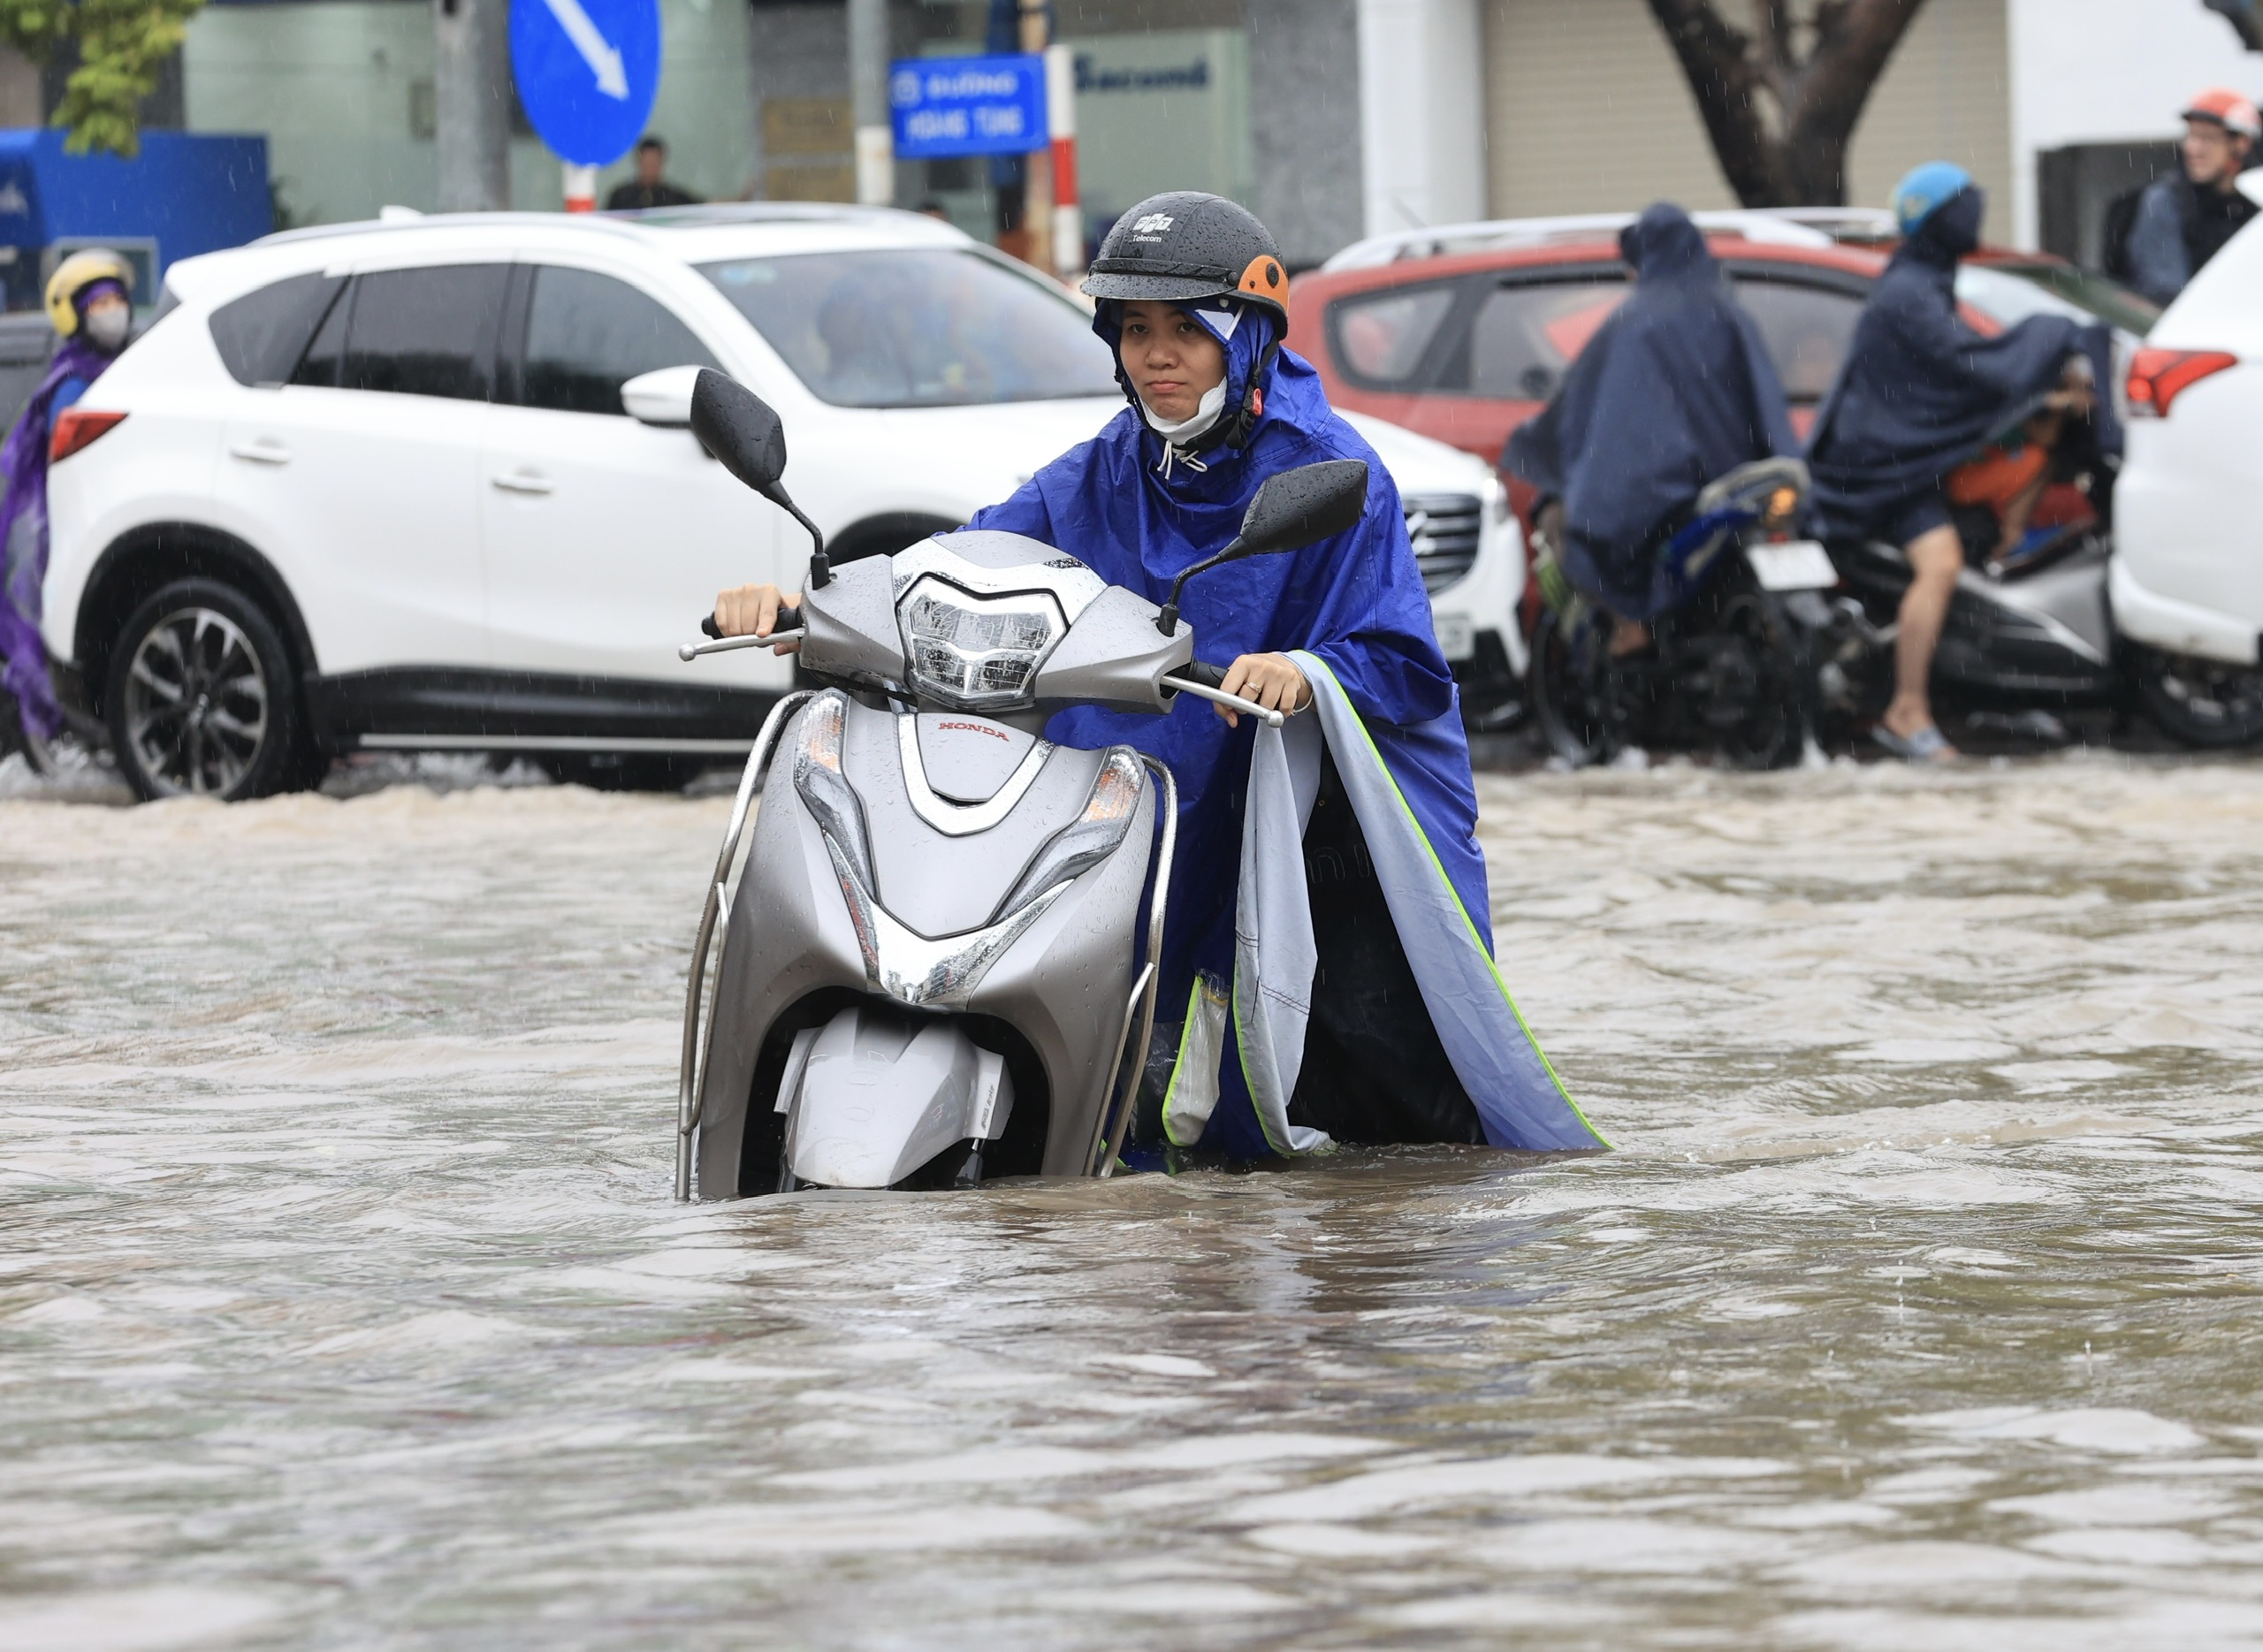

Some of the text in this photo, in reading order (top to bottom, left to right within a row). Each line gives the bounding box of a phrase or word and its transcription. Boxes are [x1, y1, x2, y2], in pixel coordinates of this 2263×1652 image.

[1132, 213, 1174, 232] FPT
[1132, 234, 1162, 243] Telecom
[939, 722, 1010, 742] HONDA
